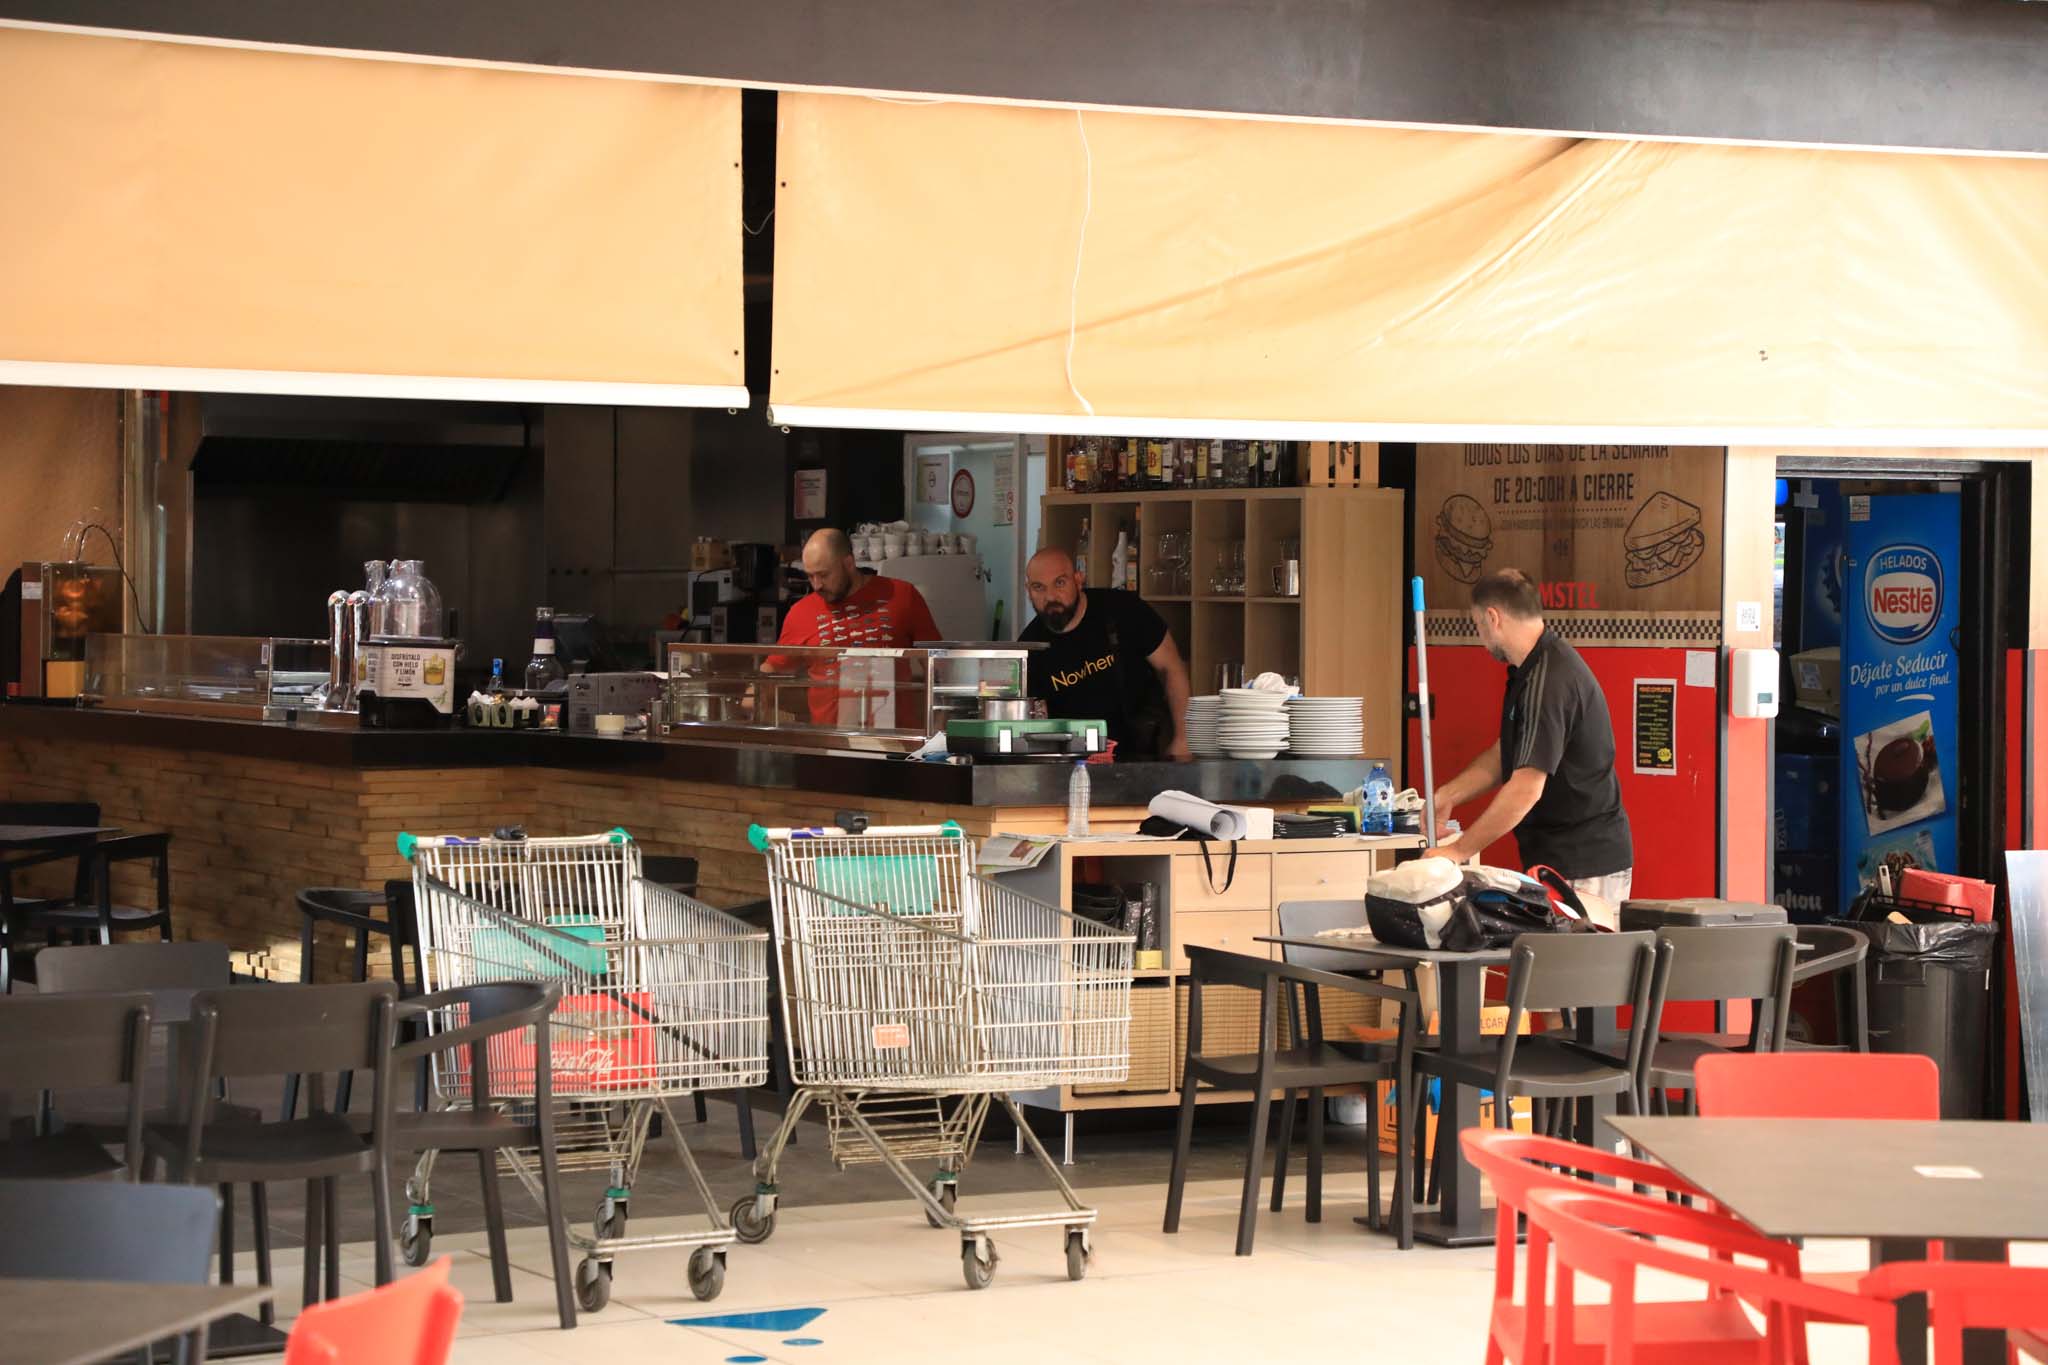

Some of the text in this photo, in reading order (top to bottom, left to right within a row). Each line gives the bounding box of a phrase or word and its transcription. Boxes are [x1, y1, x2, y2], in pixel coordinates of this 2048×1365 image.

[1507, 444, 1529, 464] LOS
[1494, 473, 1634, 503] DE 20:00H A CIERRE
[1879, 555, 1928, 571] HELADOS
[1539, 582, 1599, 609] MSTEL
[1874, 588, 1933, 614] Nestlé
[1050, 654, 1115, 691] Nowher
[1850, 650, 1948, 689] Déjate Seducir
[1875, 683, 1890, 699] por
[1891, 682, 1902, 692] un
[1905, 676, 1927, 690] dulce
[1776, 887, 1822, 911] ahou
